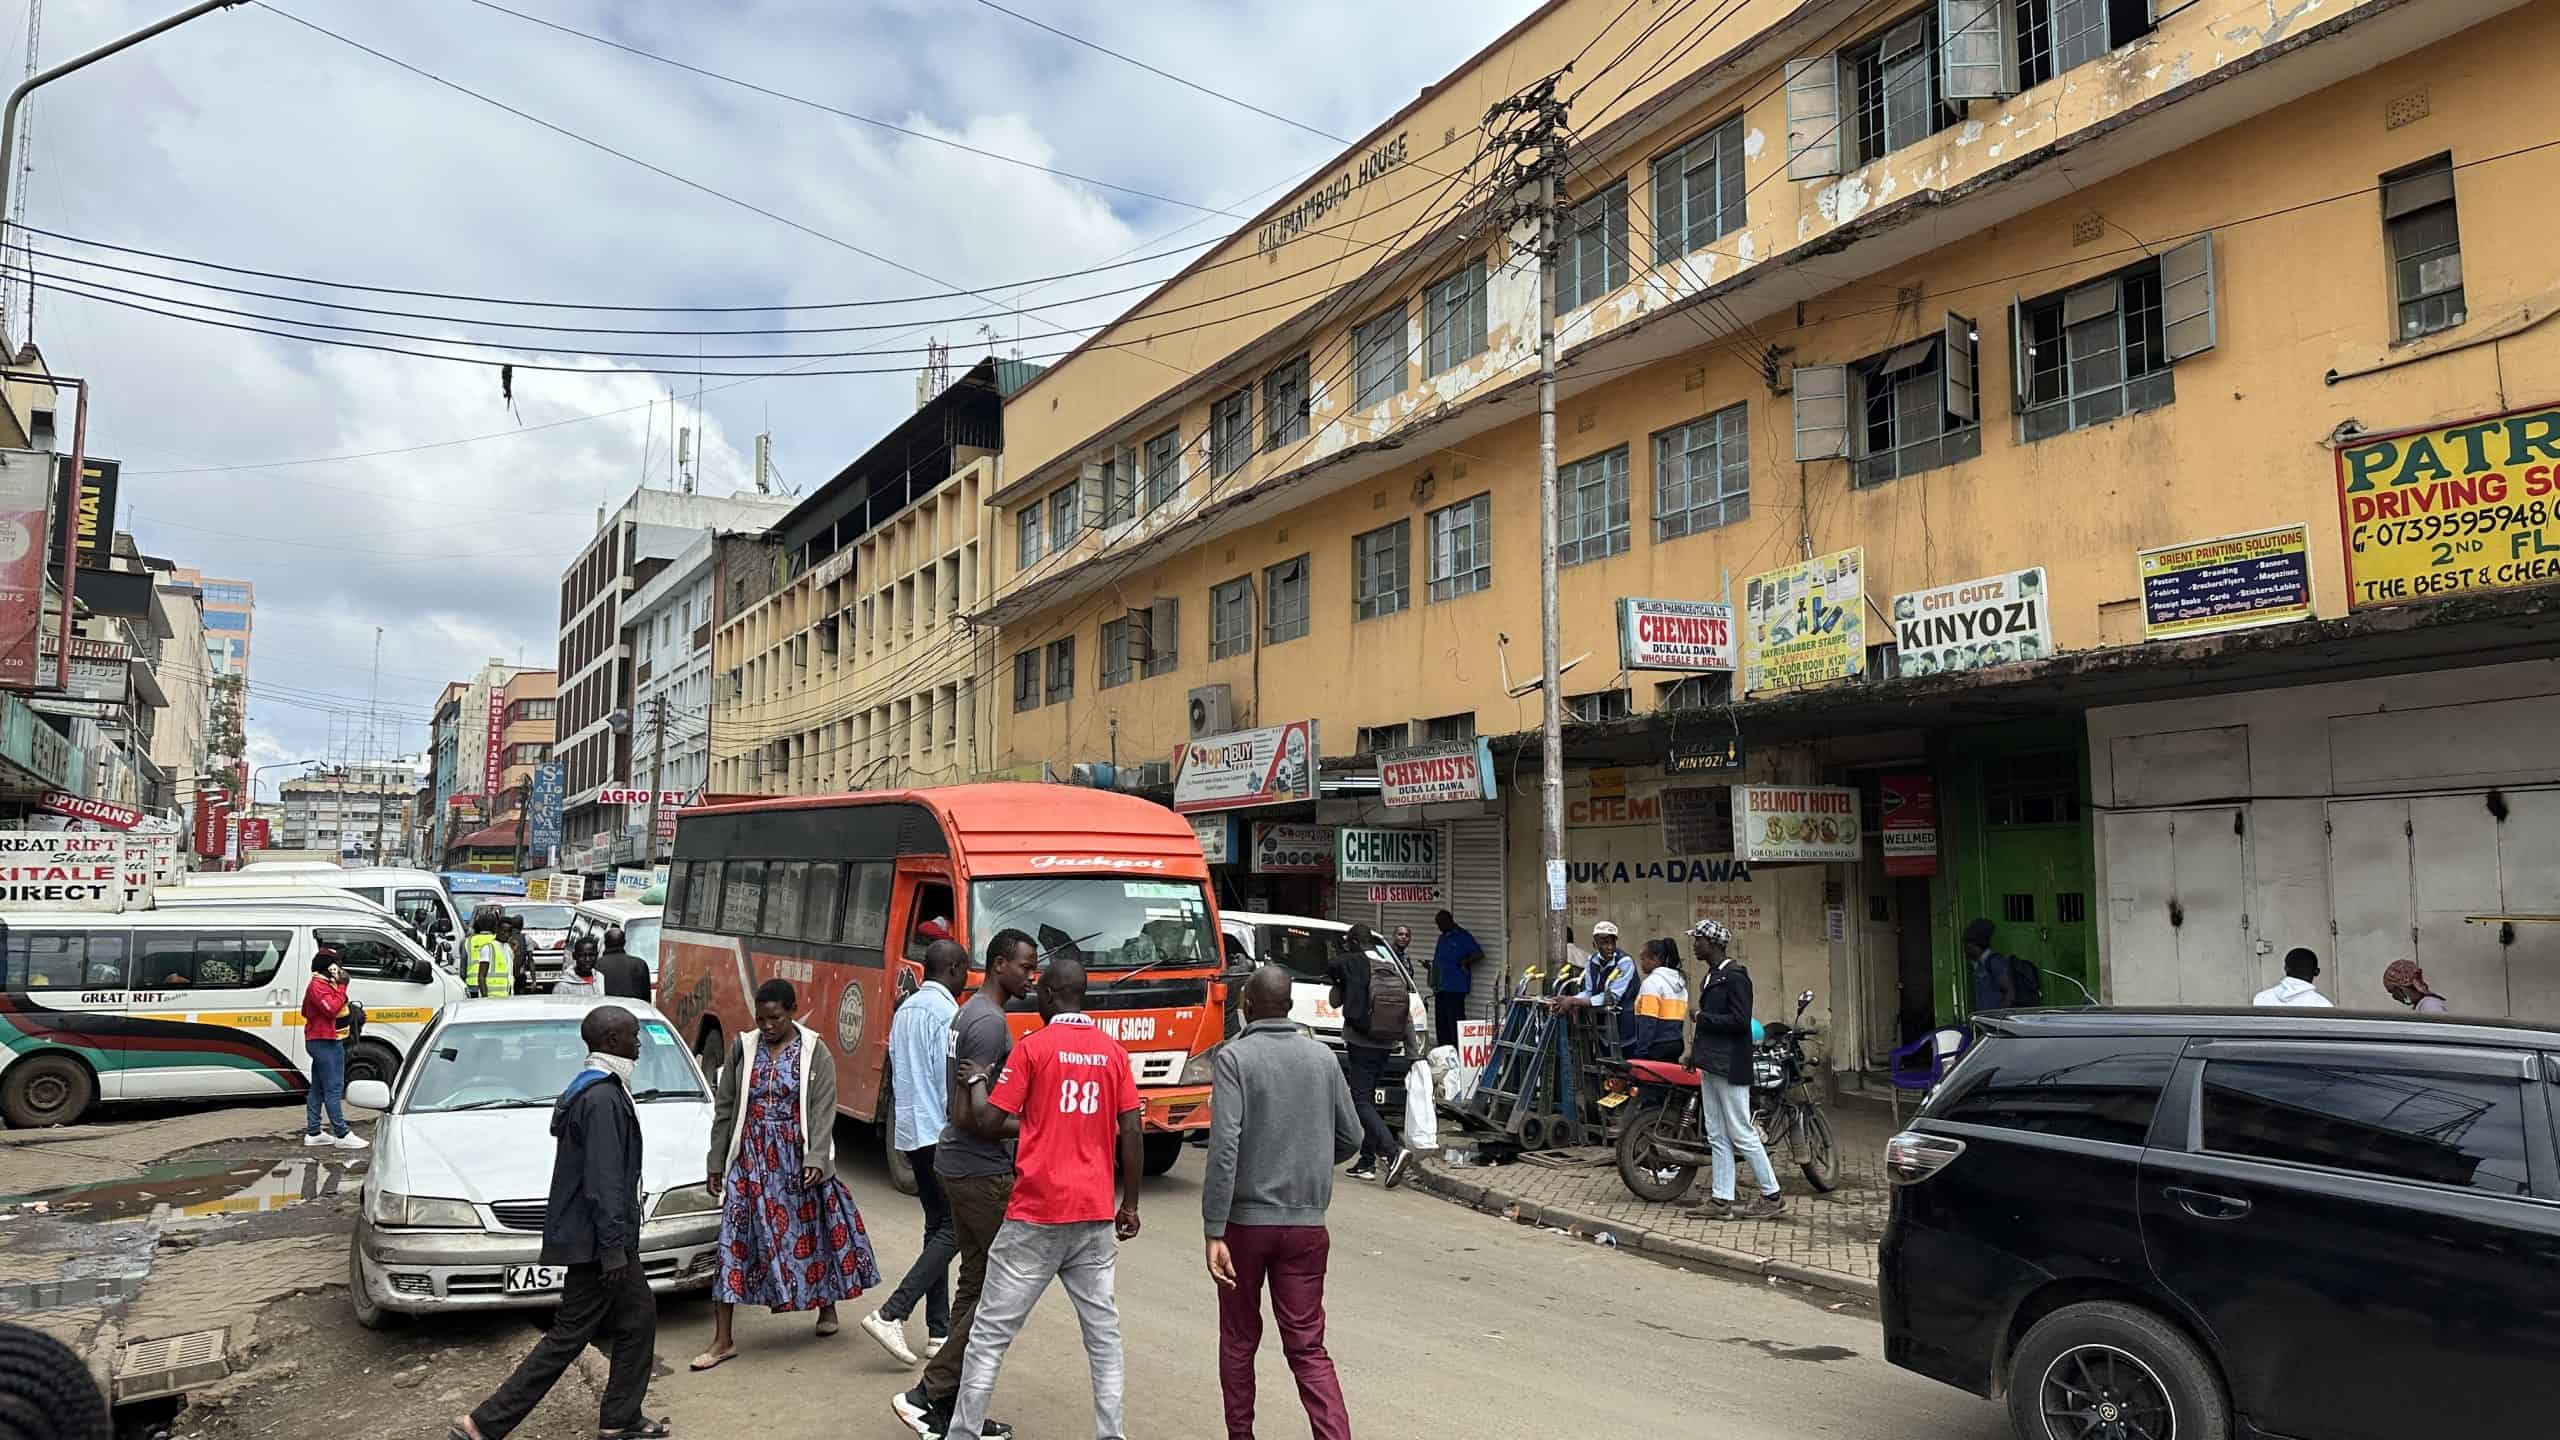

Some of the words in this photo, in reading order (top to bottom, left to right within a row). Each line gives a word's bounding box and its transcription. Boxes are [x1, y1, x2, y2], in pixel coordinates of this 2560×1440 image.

[1358, 131, 1409, 188] HOUSE
[2352, 473, 2507, 524] DRIVING
[2160, 551, 2193, 566] ORIENT
[2196, 543, 2243, 559] PRINTING
[2246, 532, 2303, 551] SOLUTIONS
[2432, 539, 2484, 567] 2ND
[2202, 566, 2239, 578] Branding
[2259, 568, 2299, 580] Magazines
[2414, 568, 2474, 594] BEST
[2479, 566, 2492, 585] &
[1922, 591, 1954, 611] CITI
[1959, 582, 2005, 604] CUTZ
[1639, 615, 1728, 646] CHEMISTS
[1901, 599, 2037, 650] KINYOZI
[1818, 634, 1847, 648] STAMPS
[1653, 644, 1678, 654] DUKA
[1681, 644, 1692, 655] LA
[1694, 645, 1717, 656] DAWA
[1641, 654, 1691, 665] WHOLESALE
[1702, 657, 1729, 668] RETAIL
[1779, 662, 1801, 676] FLOOR
[1803, 658, 1825, 672] ROOM
[1772, 676, 1788, 688] TEL
[1679, 755, 1724, 769] KINYOZI
[1383, 755, 1476, 788] CHEMISTS
[1399, 784, 1424, 795] DUKA
[1426, 783, 1437, 793] LA
[1439, 781, 1465, 792] DAWA
[1447, 790, 1477, 800] RETAIL
[599, 790, 685, 803] AGROET
[1749, 791, 1807, 813] BELMOT
[1809, 792, 1853, 814] HOTEL
[44, 793, 136, 825] OPTICIANS
[1569, 798, 1661, 823] CHEMI
[0, 839, 60, 851] REAT
[66, 838, 118, 851] RIFT
[1885, 831, 1935, 845] WELLMED
[1346, 832, 1433, 863] CHEMISTS
[1765, 848, 1792, 858] QUALITY
[1030, 855, 1166, 870] Jackpot
[1346, 866, 1371, 879] Wellmed
[1372, 867, 1421, 880] Pharmaceuticals
[1635, 863, 1664, 879] LA
[1667, 859, 1752, 883] DAWA
[621, 875, 649, 887] KITALE
[1369, 886, 1388, 901] LAB
[1390, 886, 1434, 902] SERVICES
[81, 993, 125, 1004] GREAT
[132, 993, 165, 1003] RIFT
[236, 1015, 276, 1024] KITALE
[375, 1012, 420, 1020] BUNGOMA
[1121, 1017, 1156, 1041] SACCO
[1059, 1050, 1108, 1067] RODNEY
[1059, 1080, 1100, 1114] 88
[507, 1267, 552, 1290] KAS
